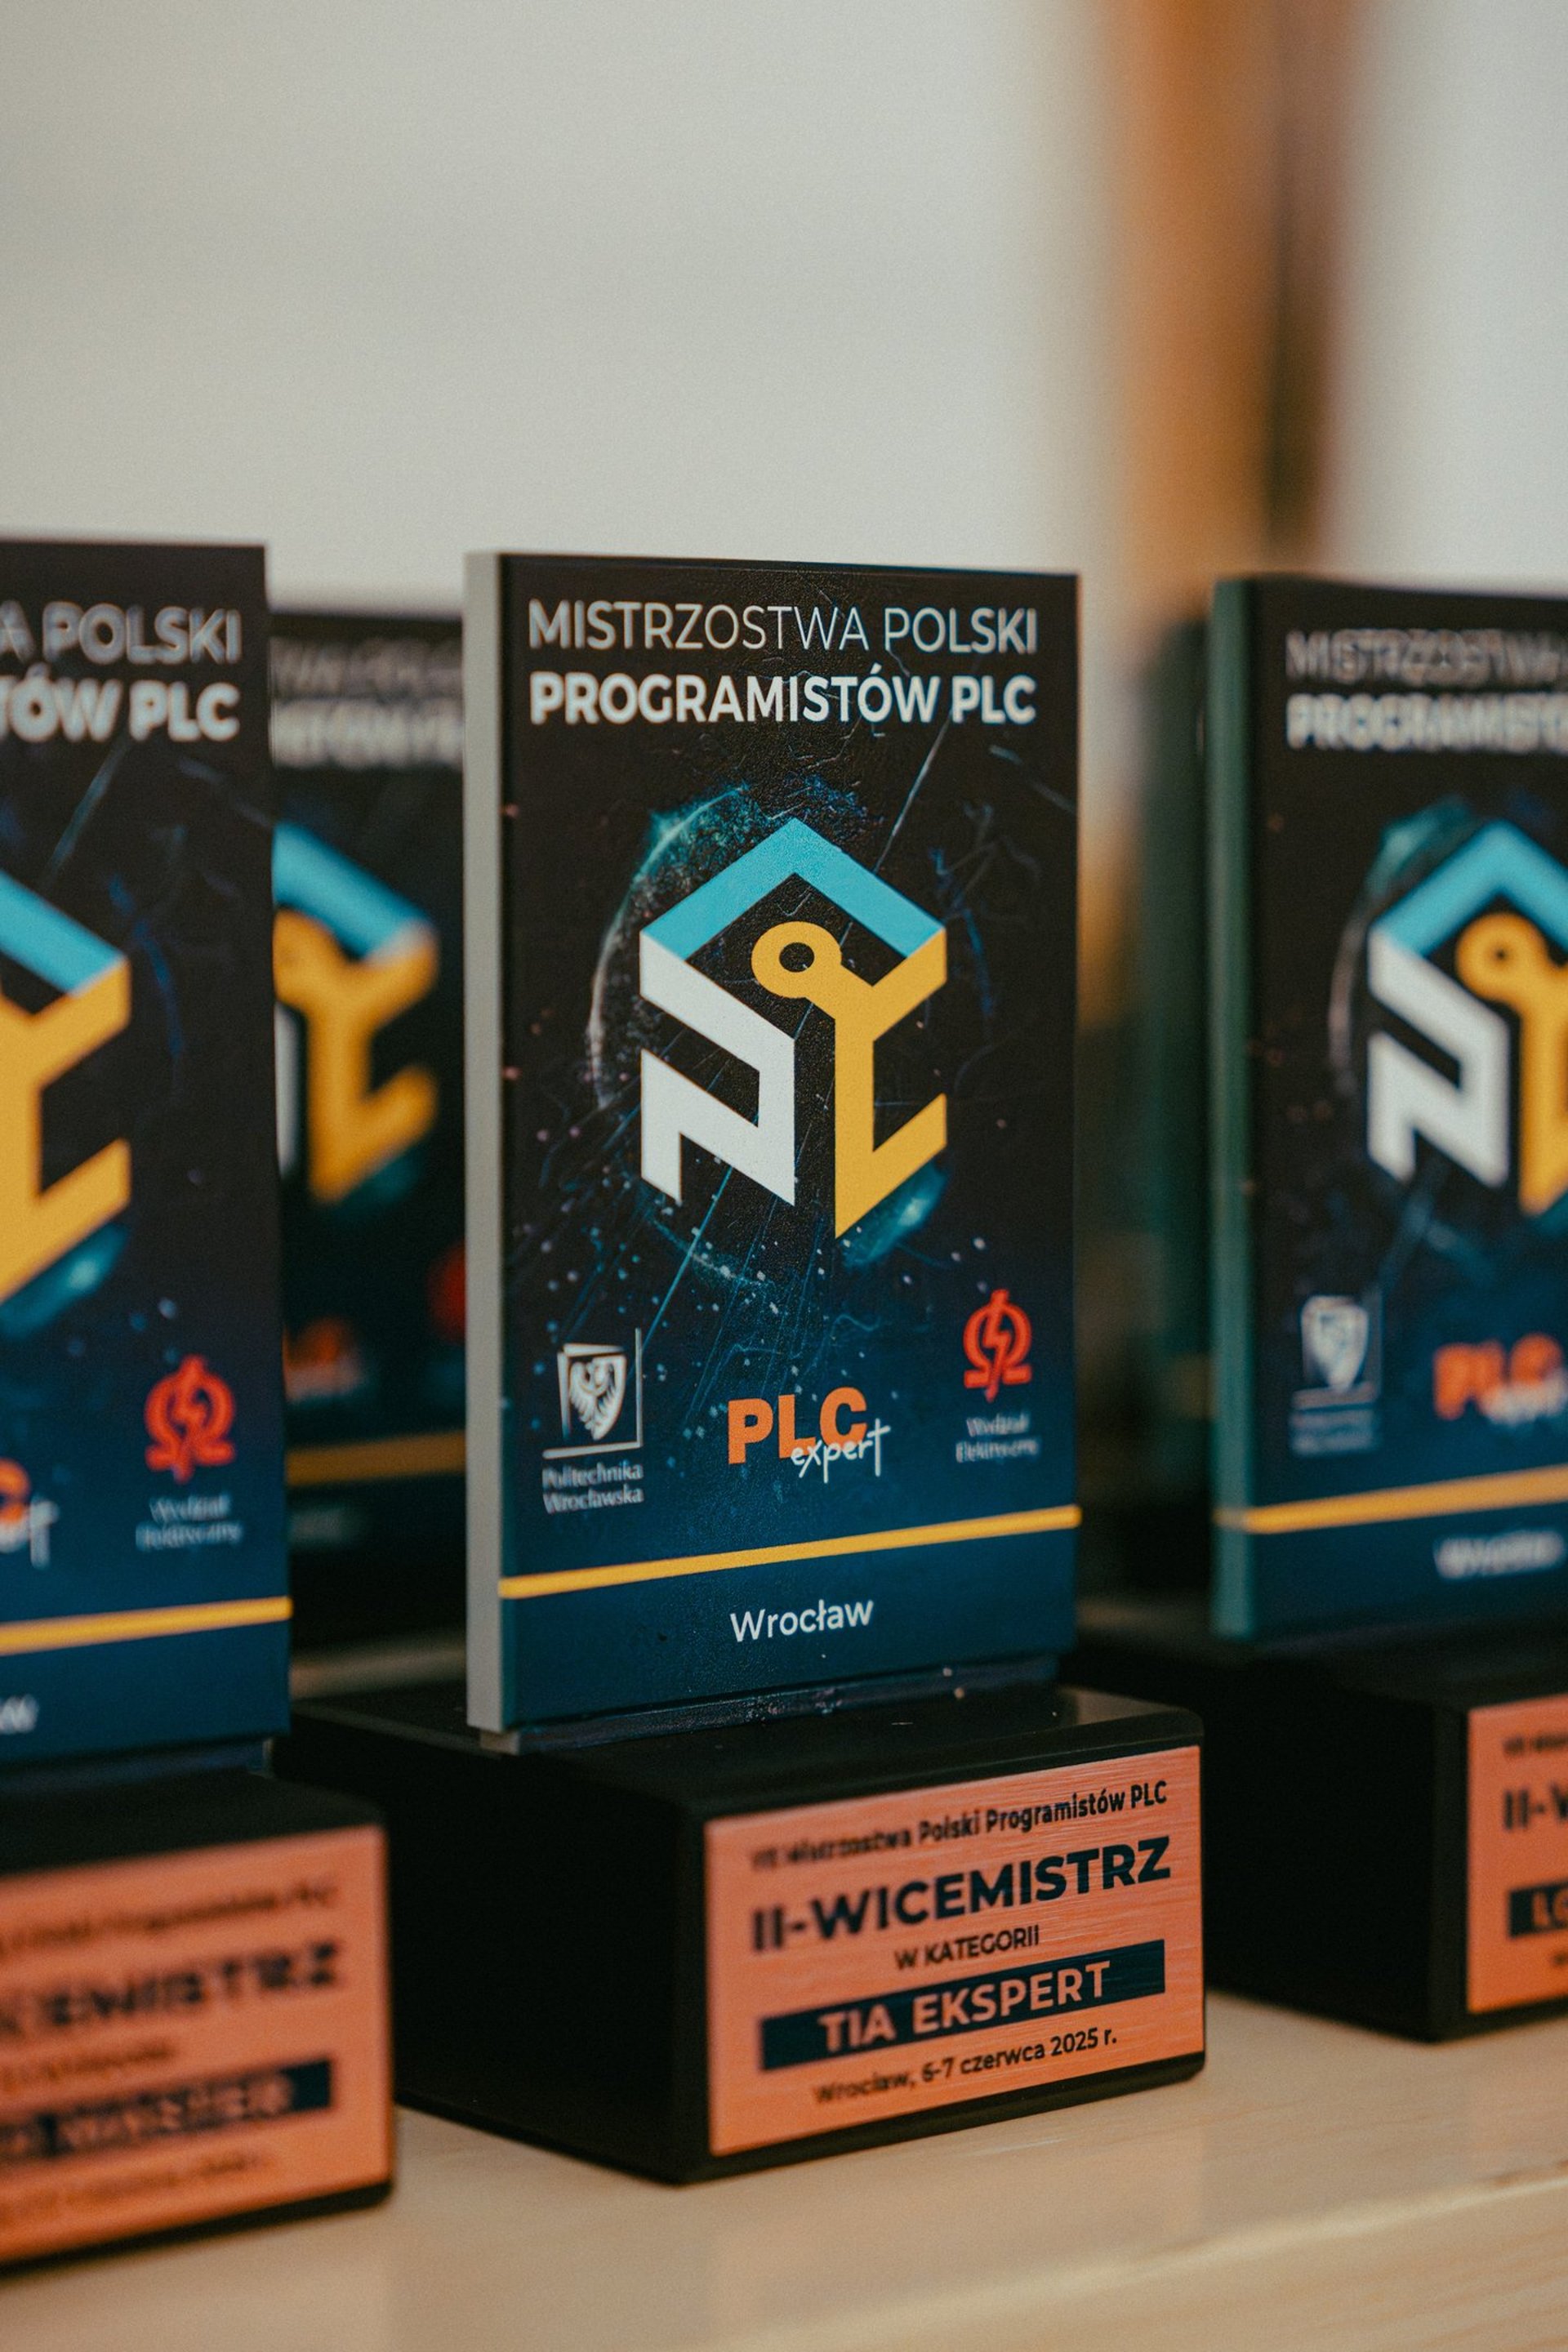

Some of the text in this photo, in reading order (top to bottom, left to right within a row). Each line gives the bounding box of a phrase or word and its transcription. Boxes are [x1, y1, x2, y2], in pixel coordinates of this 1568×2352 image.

[42, 601, 242, 665] POLSKI
[528, 599, 1037, 654] MISTRZOSTWA POLSKI
[129, 680, 240, 742] PLC
[529, 663, 939, 725] PROGRAMISTÓW
[951, 675, 1036, 724] PLC
[728, 1387, 868, 1464] PLC
[791, 1418, 891, 1484] expert
[542, 1460, 644, 1490] Politechnika
[729, 1599, 874, 1643] Wrocław
[918, 1808, 982, 1846] Polski
[986, 1788, 1125, 1834] Programistów
[1130, 1780, 1168, 1809] PLC
[750, 1834, 1171, 1953] II-WICEMISTRZ
[894, 1923, 1040, 1971] W KATEGORII
[817, 1961, 1111, 2055] TIA EKSPERT
[921, 2056, 955, 2082] 6-7
[960, 2042, 1045, 2076] czerwca
[1049, 2026, 1098, 2056] 2025
[1102, 2025, 1119, 2047] r.
